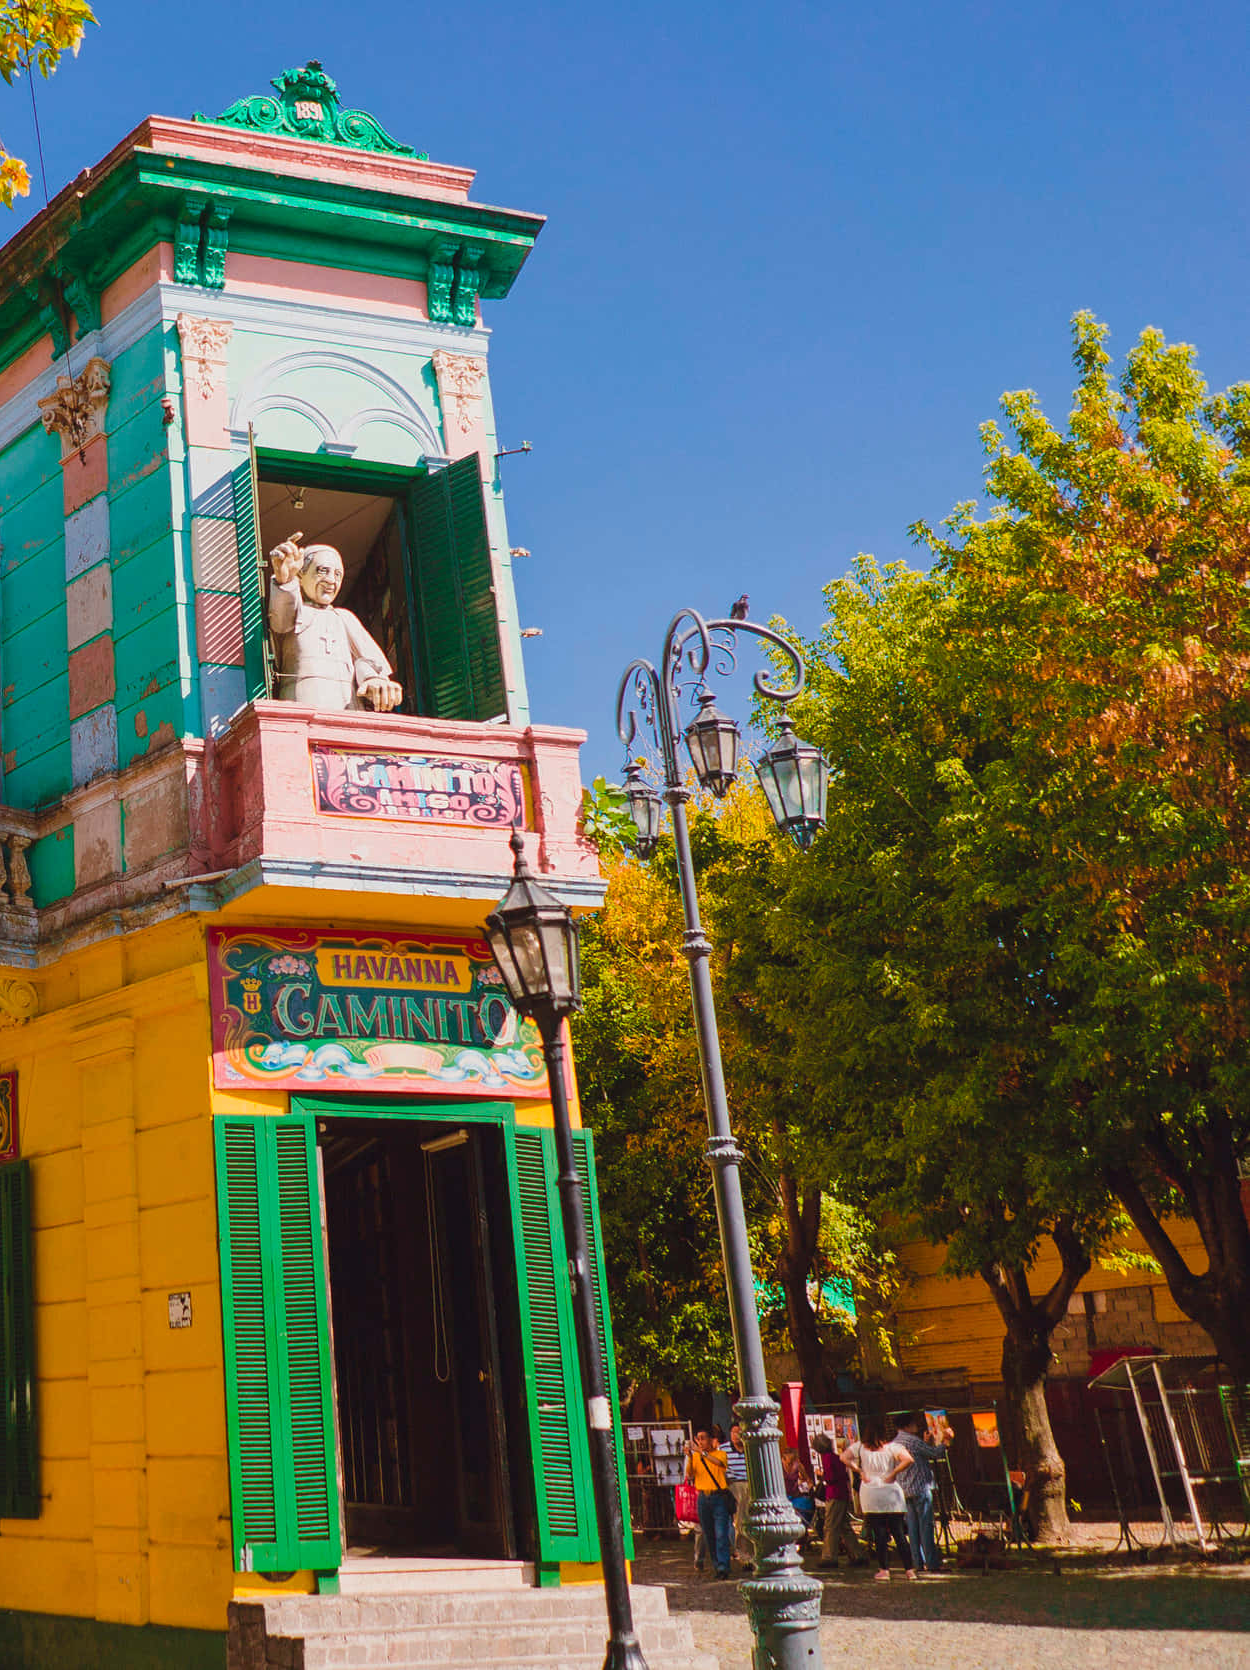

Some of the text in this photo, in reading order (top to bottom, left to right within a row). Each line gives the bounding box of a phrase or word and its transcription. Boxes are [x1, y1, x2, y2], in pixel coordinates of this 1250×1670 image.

[347, 757, 495, 794] CAMINITO
[379, 788, 470, 810] AMIGO
[333, 954, 461, 985] HAVANNA
[246, 994, 258, 1010] H
[272, 982, 518, 1048] CAMINITO
